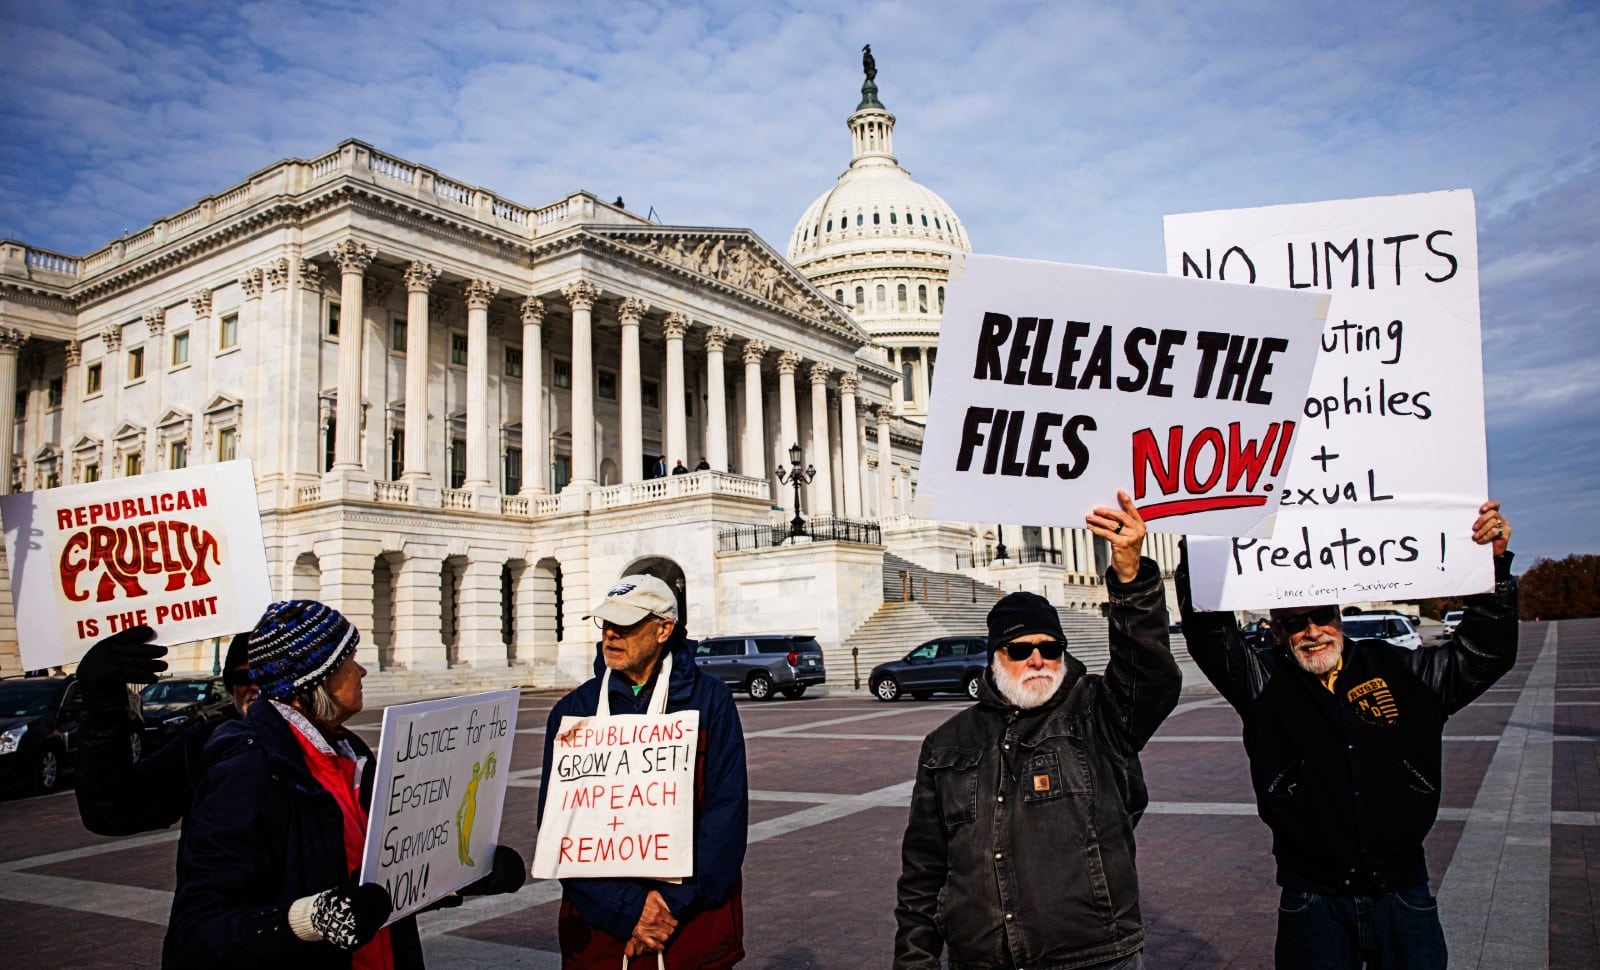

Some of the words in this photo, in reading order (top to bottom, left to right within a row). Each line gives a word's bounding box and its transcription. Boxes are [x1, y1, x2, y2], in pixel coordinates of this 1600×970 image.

[1182, 245, 1256, 284] NO
[1287, 229, 1458, 290] LIMITS
[973, 311, 1187, 398] RELEASE
[1193, 330, 1289, 405] THE
[1321, 319, 1403, 365] uting
[1303, 375, 1432, 429] ophiles
[955, 406, 1098, 480] FILES
[1132, 420, 1296, 500] NOW!
[1311, 445, 1339, 472] +
[1280, 468, 1394, 505] exuaL
[57, 488, 208, 530] REPUBLICAN
[60, 520, 221, 602] CRUELTY
[1353, 580, 1400, 592] Survivor
[77, 619, 99, 639] IS
[106, 609, 148, 633] THE
[156, 596, 217, 625] POINT
[397, 720, 458, 763] JUSTICE
[466, 709, 486, 746] for
[489, 704, 508, 740] the
[557, 751, 611, 778] GROW
[615, 749, 630, 775] A
[641, 744, 690, 774] SET!
[388, 774, 452, 816] EPSTEIN
[562, 782, 677, 811] IMPEACH
[381, 820, 450, 868] SURVIVORS
[607, 816, 624, 831] +
[558, 834, 670, 864] REMOVE
[386, 862, 430, 912] NOW!
